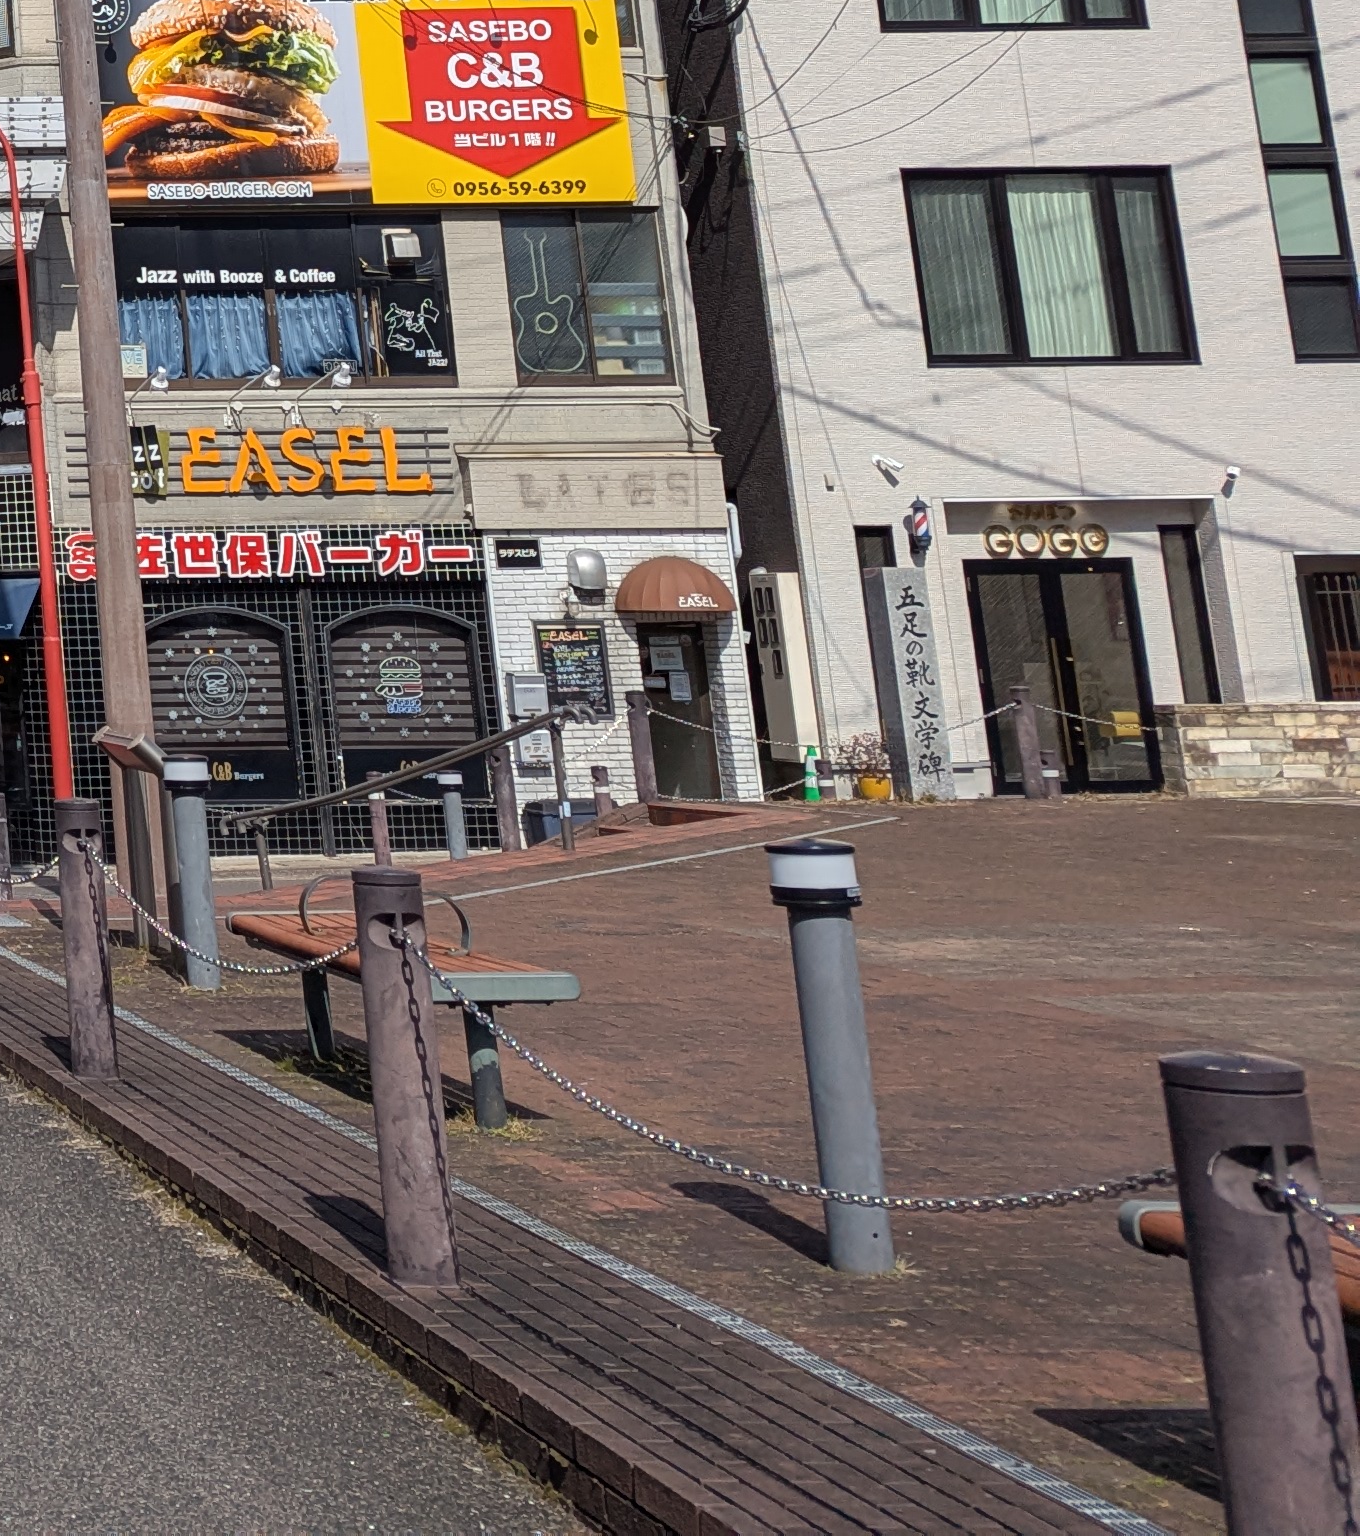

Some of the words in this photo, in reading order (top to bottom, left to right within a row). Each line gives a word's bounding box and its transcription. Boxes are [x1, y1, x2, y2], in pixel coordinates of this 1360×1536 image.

[427, 20, 552, 43] SASEBO
[446, 52, 544, 88] C&B
[425, 98, 573, 123] BURGERS
[147, 182, 314, 199] SASEBO-BURGER.COM
[453, 179, 587, 197] 0956-59-6399
[136, 267, 177, 284] Jazz
[183, 270, 215, 284] with
[220, 269, 264, 284] Booze
[274, 269, 287, 283] &
[289, 268, 335, 283] Coffee
[181, 427, 433, 494] EASEL
[982, 523, 1109, 559] GOGO
[678, 596, 718, 607] EASEL
[550, 631, 588, 642] EASEL
[895, 584, 947, 782] 五足の靴文学碑
